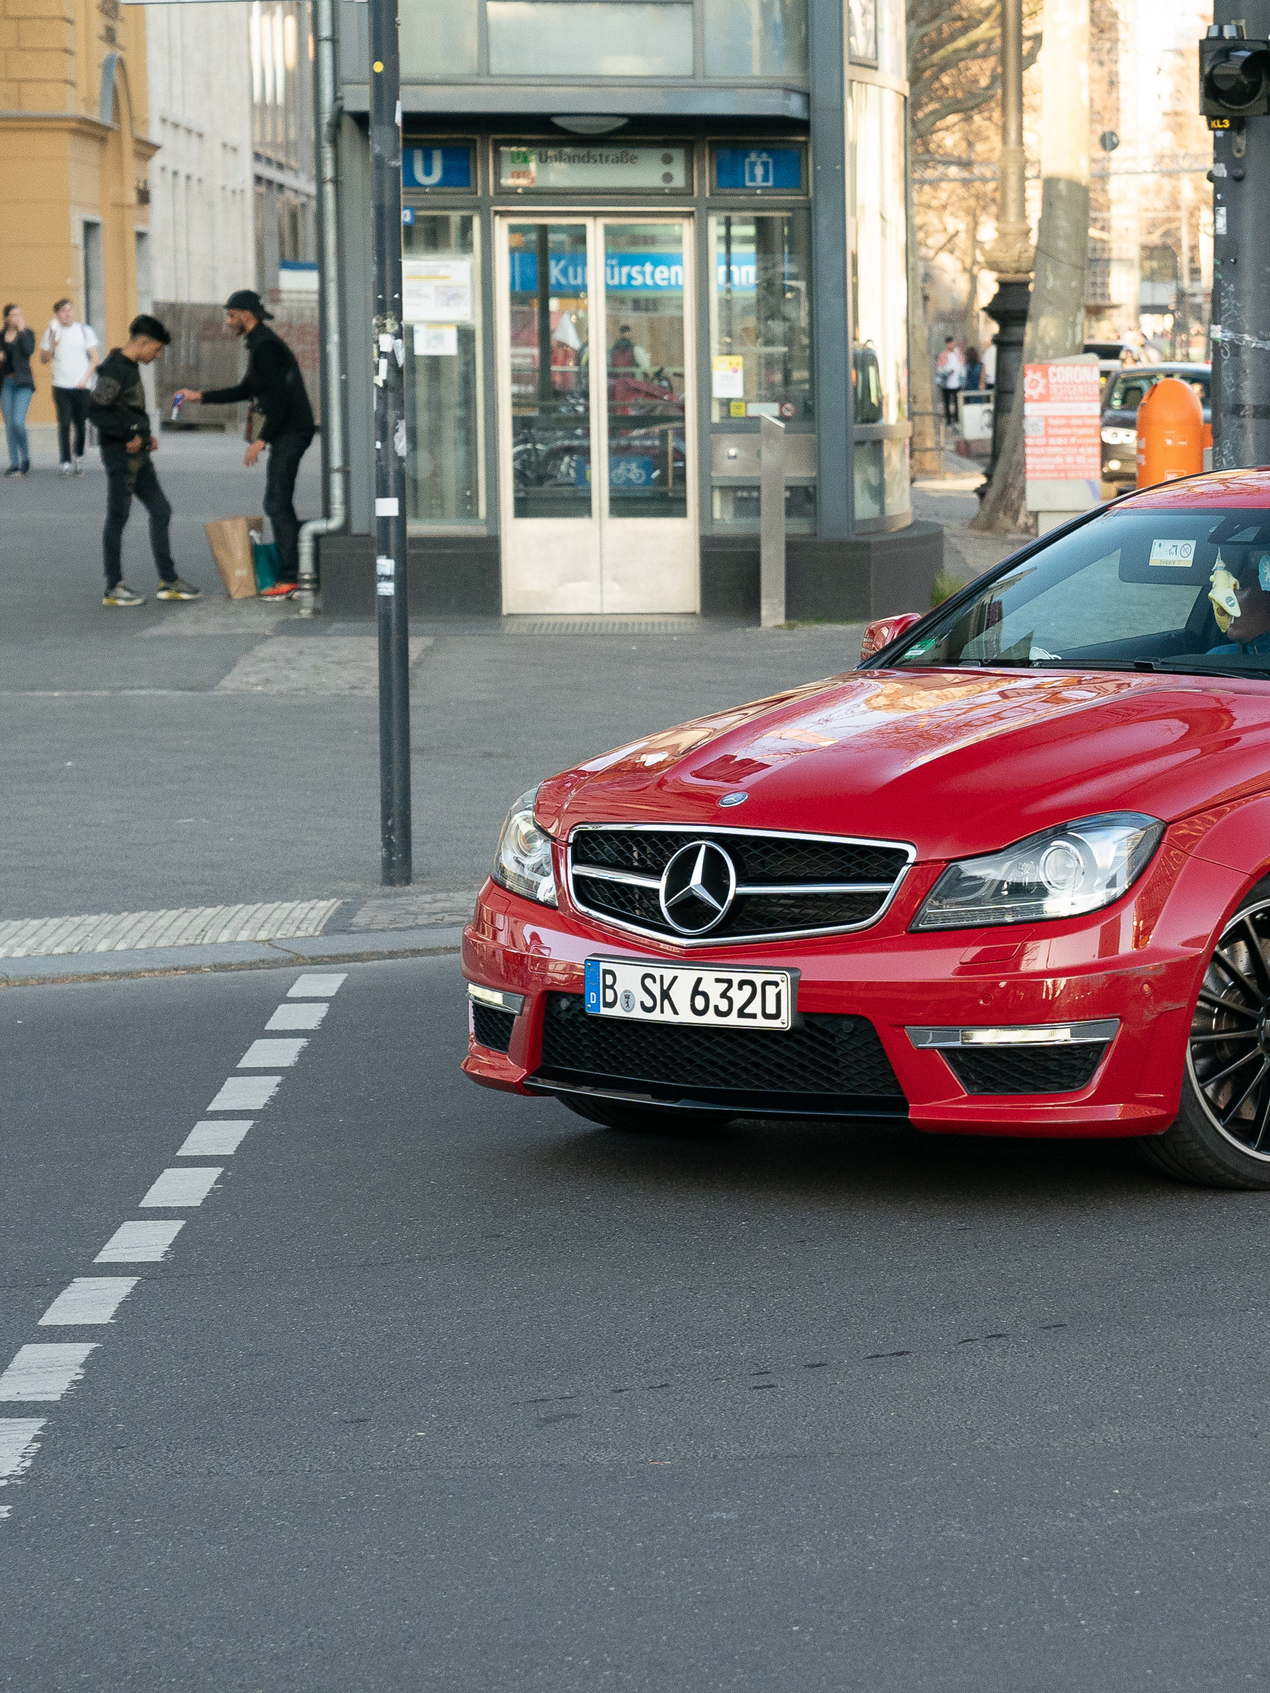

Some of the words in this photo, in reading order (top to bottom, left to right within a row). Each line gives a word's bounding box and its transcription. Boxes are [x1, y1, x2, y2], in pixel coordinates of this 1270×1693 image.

[1210, 119, 1230, 128] KL3
[413, 149, 443, 186] U
[1048, 365, 1100, 384] CORONA
[590, 992, 597, 1004] D
[602, 968, 618, 1009] B
[640, 972, 679, 1015] SK
[690, 976, 782, 1020] 6320
